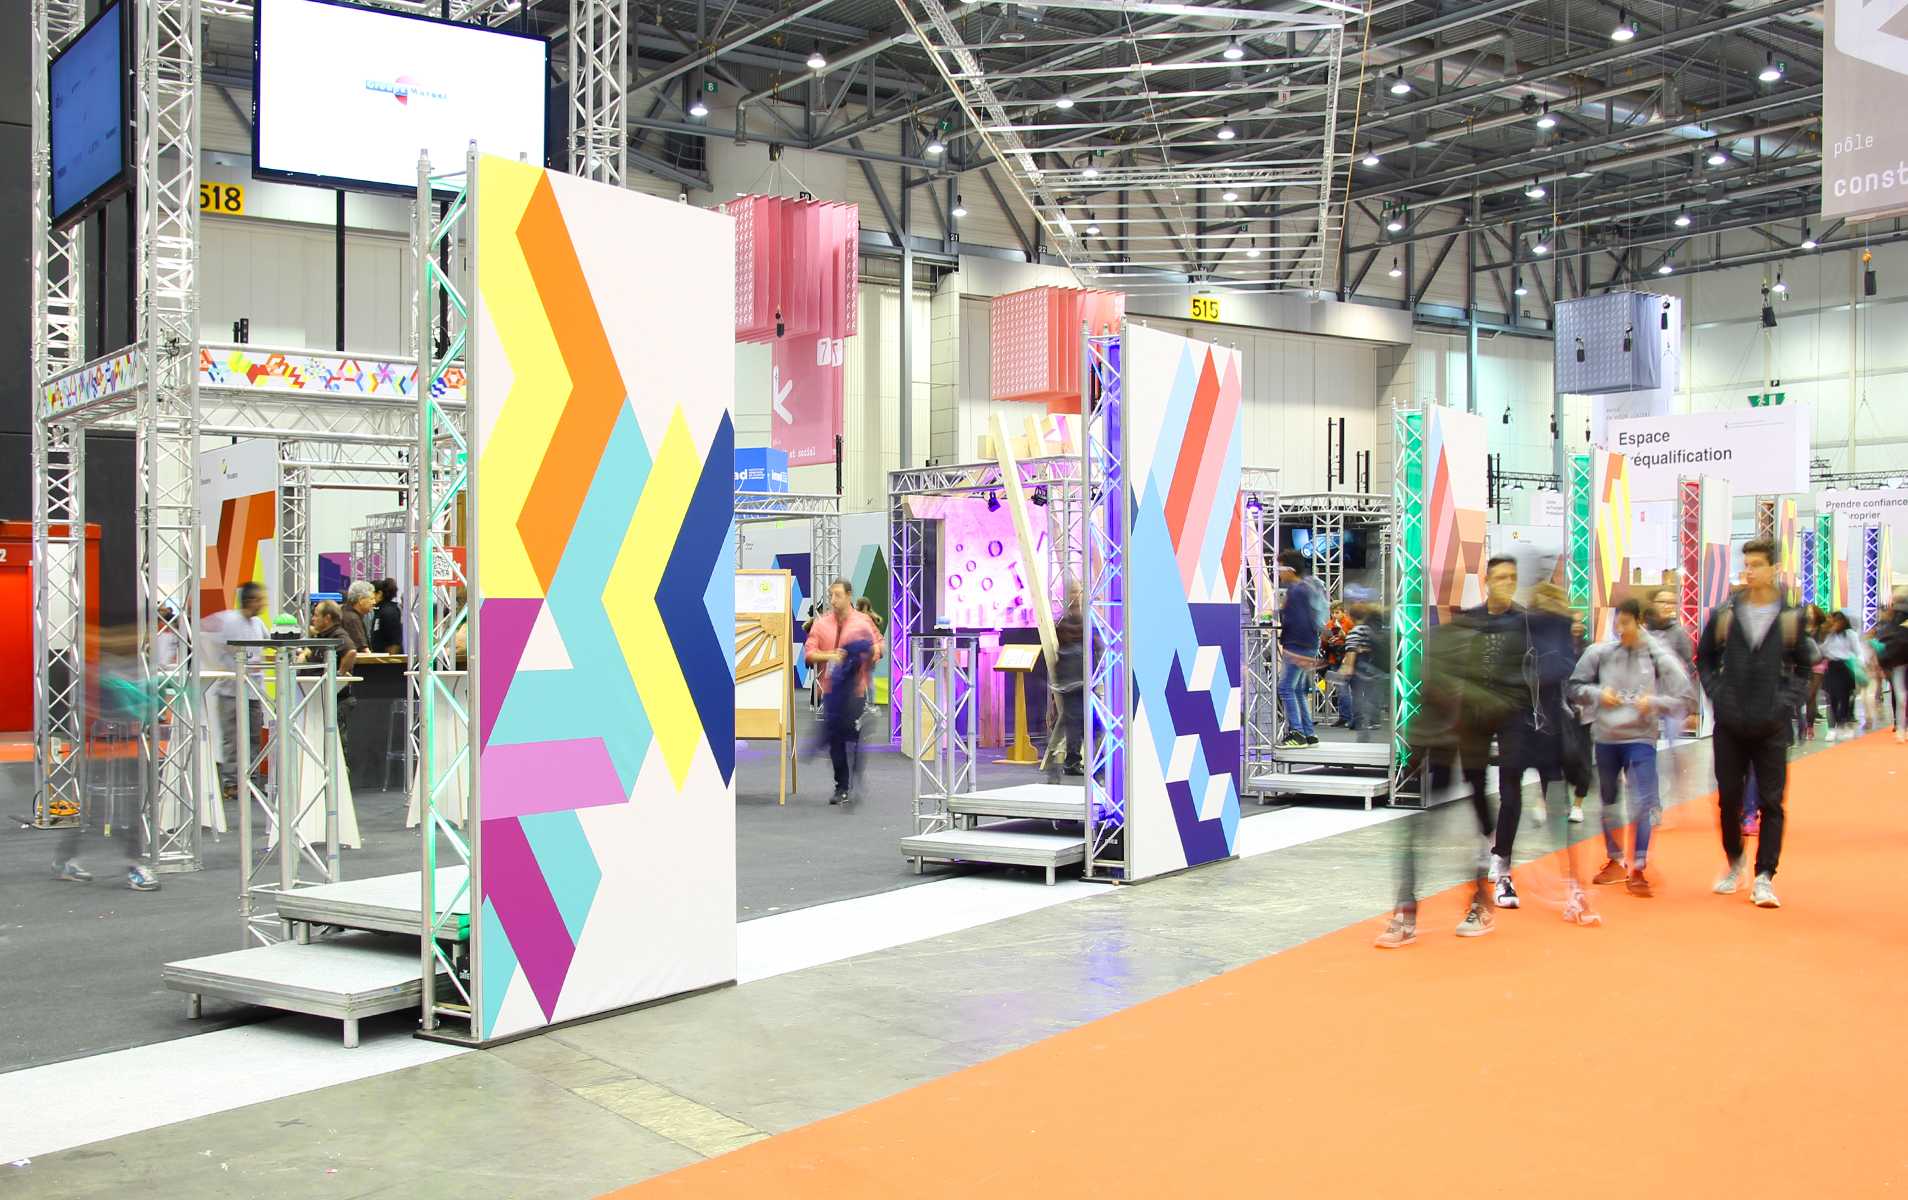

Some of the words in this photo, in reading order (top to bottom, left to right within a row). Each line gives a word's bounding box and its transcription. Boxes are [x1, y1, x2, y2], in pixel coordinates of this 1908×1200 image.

[1632, 22, 1638, 32] 6
[1779, 63, 1785, 72] 5
[366, 80, 406, 94] Groupe
[410, 88, 447, 99] Mutuel
[708, 82, 714, 91] 8
[942, 121, 948, 130] 7
[1834, 133, 1873, 159] pôle
[1834, 161, 1908, 197] const
[200, 184, 241, 211] 518
[950, 233, 958, 242] 21
[1038, 245, 1047, 253] 22
[1193, 298, 1219, 319] 515
[820, 341, 828, 363] 7
[1619, 431, 1670, 448] Espace
[789, 449, 796, 458] et
[798, 447, 816, 458] social
[1631, 447, 1732, 468] équalification
[1826, 500, 1861, 509] Prendre
[1863, 498, 1908, 508] confiance
[1849, 511, 1881, 521] roprier
